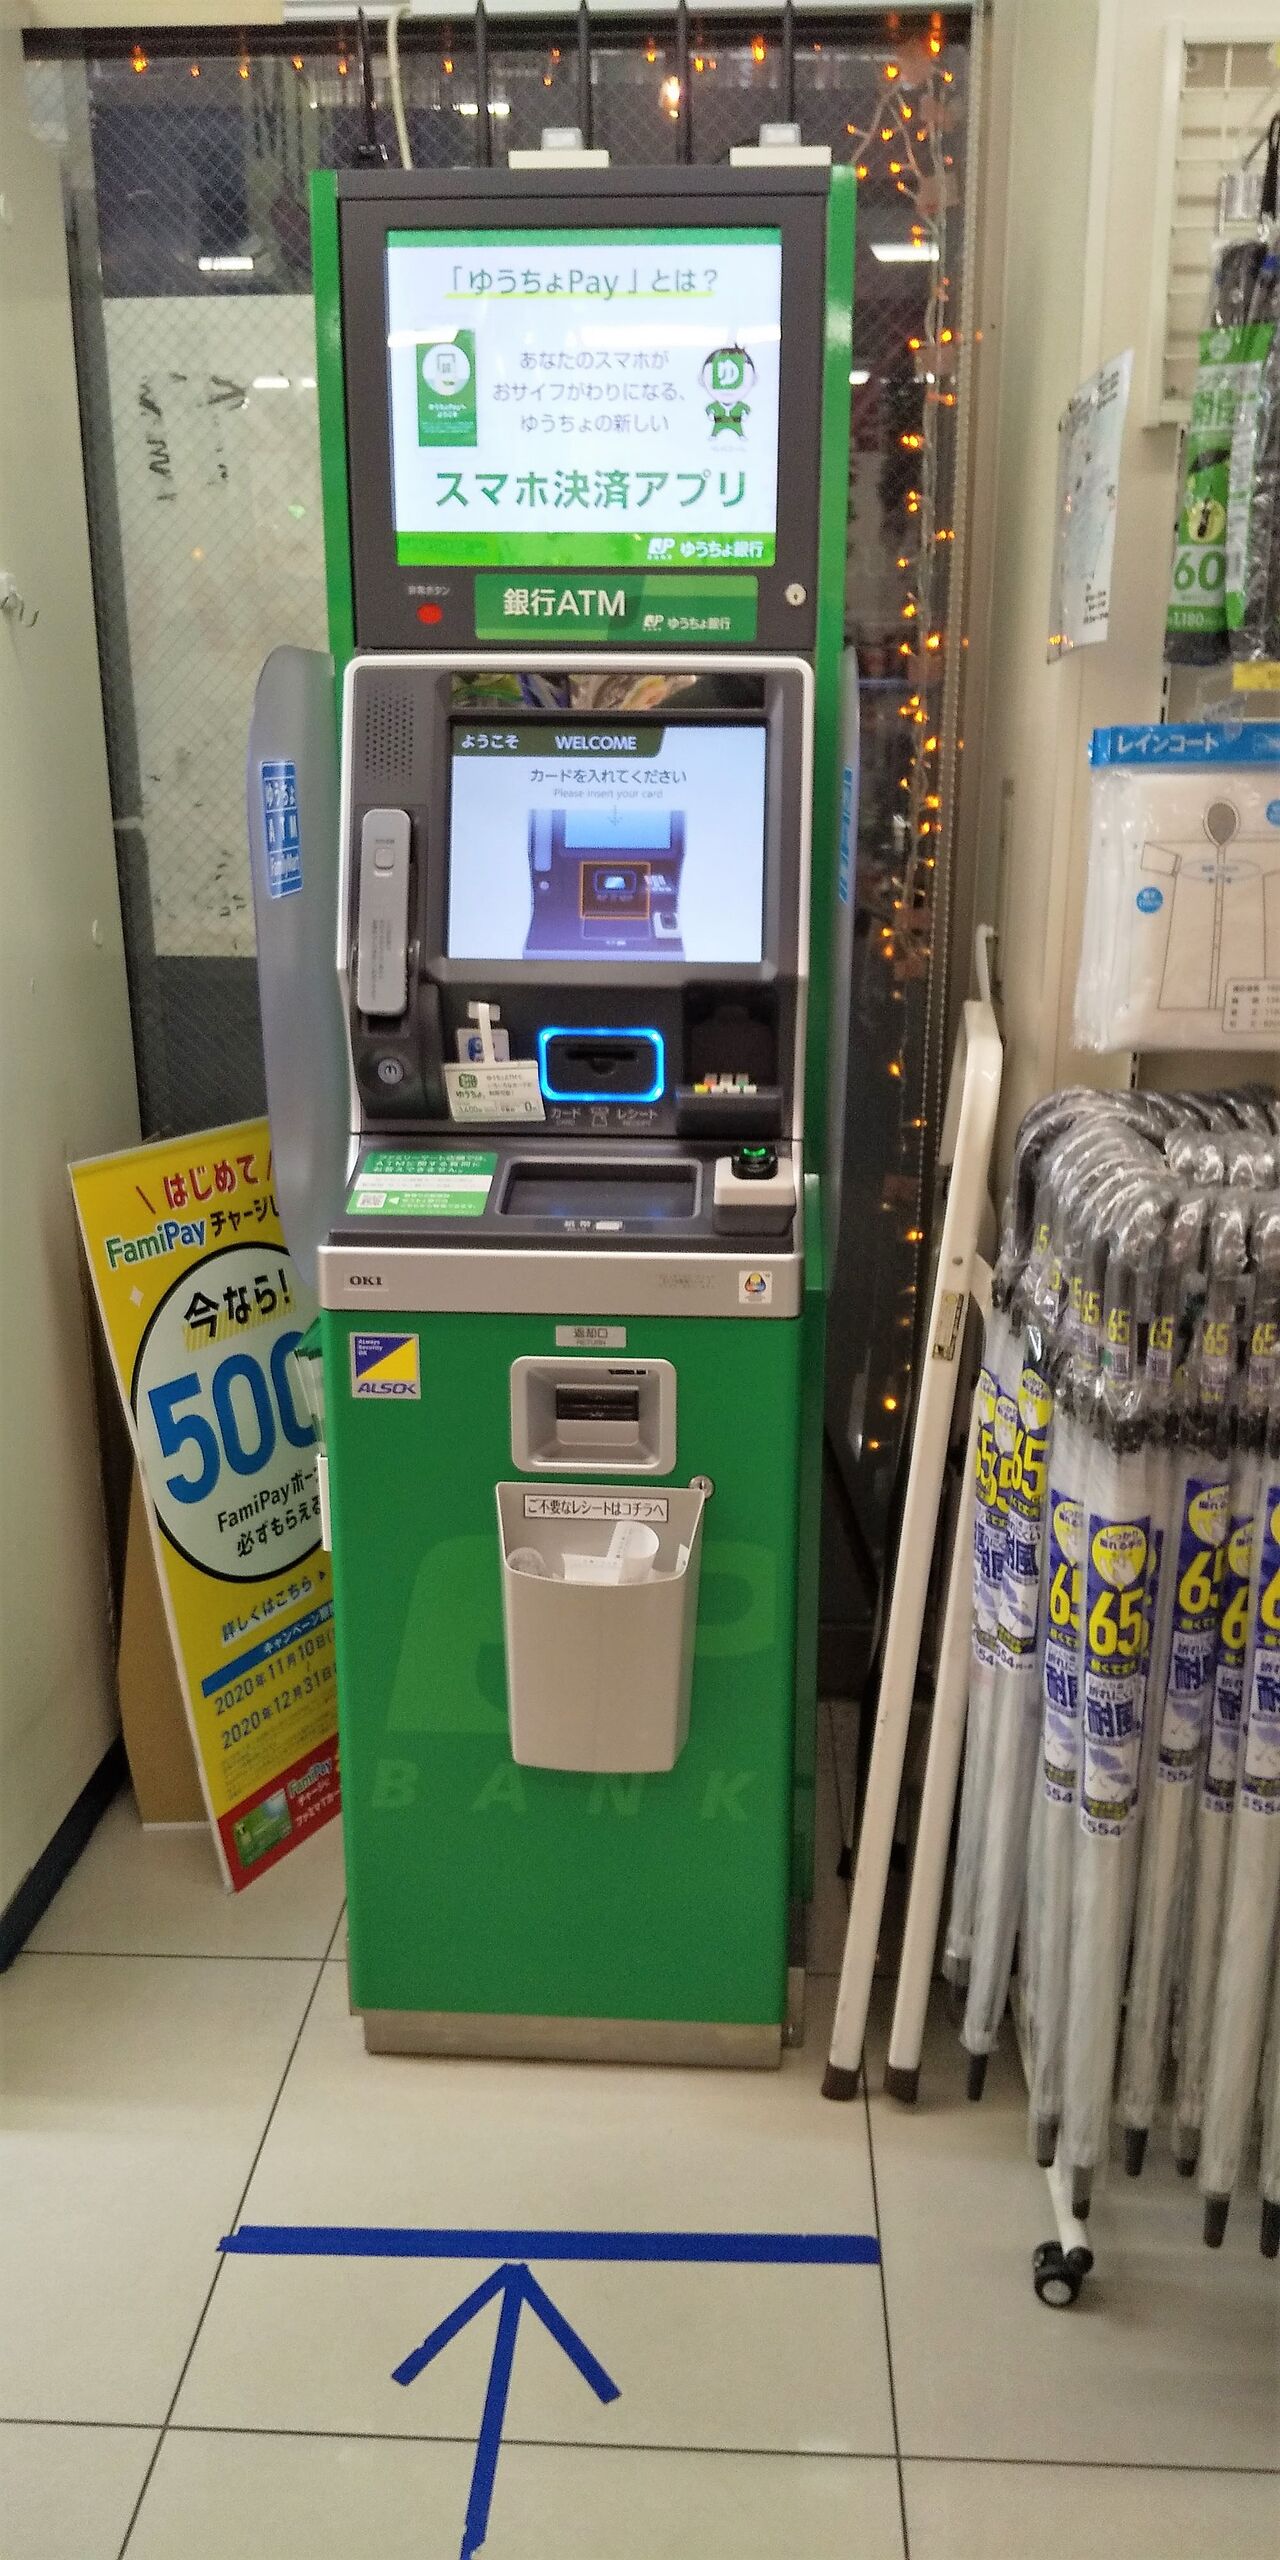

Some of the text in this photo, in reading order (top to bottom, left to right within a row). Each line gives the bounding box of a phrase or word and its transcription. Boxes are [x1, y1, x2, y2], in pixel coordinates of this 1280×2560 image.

[519, 350, 669, 371] あなたのスマホが
[493, 382, 685, 402] おサイフがわりになる、
[520, 414, 669, 435] ゆうちょの新しい
[435, 469, 746, 508] スマホ決済アプリ
[680, 540, 764, 559] ゆうちょ銀行
[1174, 551, 1226, 590] 60
[503, 587, 625, 617] 銀行ATM
[667, 617, 730, 631] ゆうちょ銀行
[461, 734, 637, 750] ようこそ WELCOME
[1117, 733, 1219, 753] レインコート
[530, 768, 687, 784] カードを入れてください
[554, 788, 663, 799] Please insert your card
[163, 1154, 258, 1210] はじめて
[104, 1220, 206, 1269] FamiPay
[349, 1276, 383, 1287] OKI
[183, 1268, 292, 1338] 今なら!
[1107, 1307, 1130, 1344] 65
[1203, 1321, 1229, 1356] 65
[358, 1382, 416, 1394] ALSOK
[1012, 1430, 1049, 1501] 65
[217, 1468, 320, 1533] FamiPayボー
[528, 1498, 664, 1518] ご不要なレシートはコチラへ
[222, 1576, 313, 1643] 詳しくはこちら
[1089, 1587, 1144, 1656] 65
